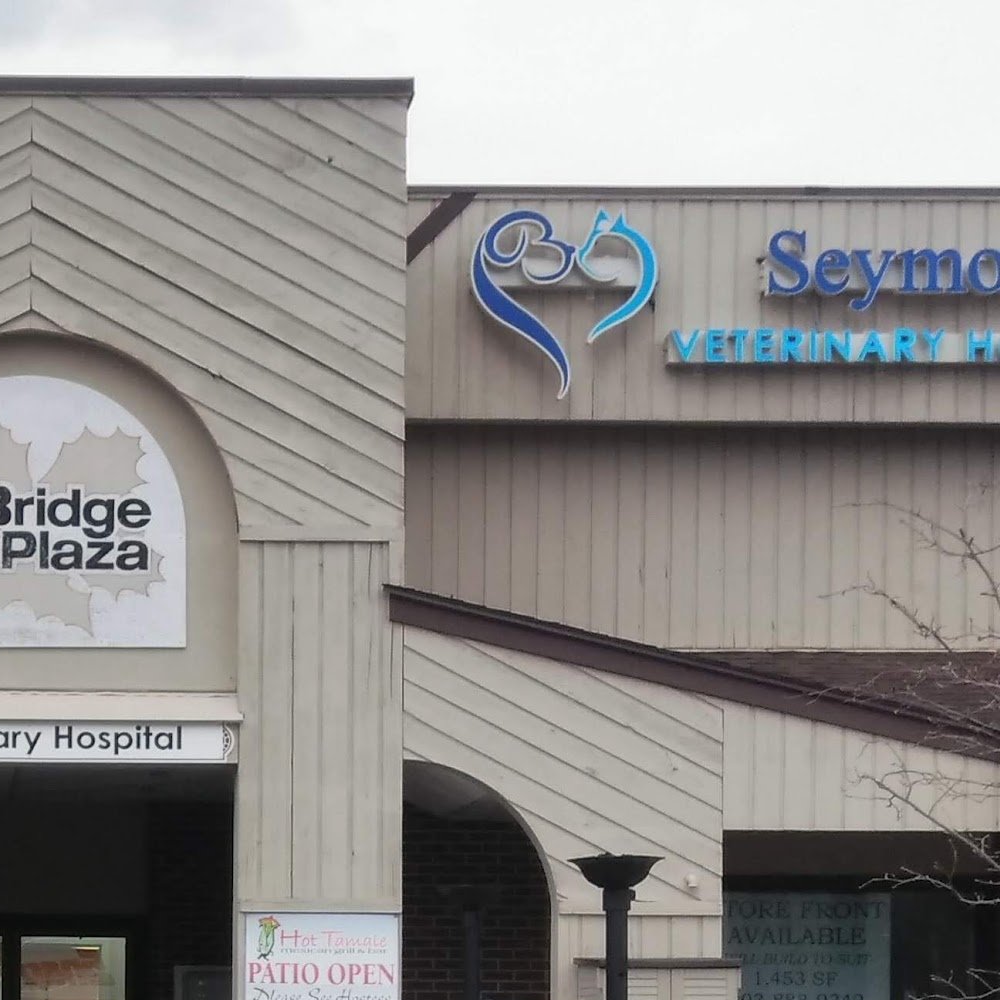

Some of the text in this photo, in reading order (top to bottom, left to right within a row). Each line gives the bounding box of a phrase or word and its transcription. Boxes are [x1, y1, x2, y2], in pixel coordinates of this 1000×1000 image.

[672, 328, 945, 362] VETERINARY
[1, 530, 150, 570] Plaza
[54, 725, 183, 755] Hospital
[727, 900, 886, 919] TORE FRONT
[280, 929, 318, 948] Hot
[727, 926, 867, 945] AVAILABLE
[248, 962, 396, 985] PATIO OPEN
[812, 970, 840, 986] SF
